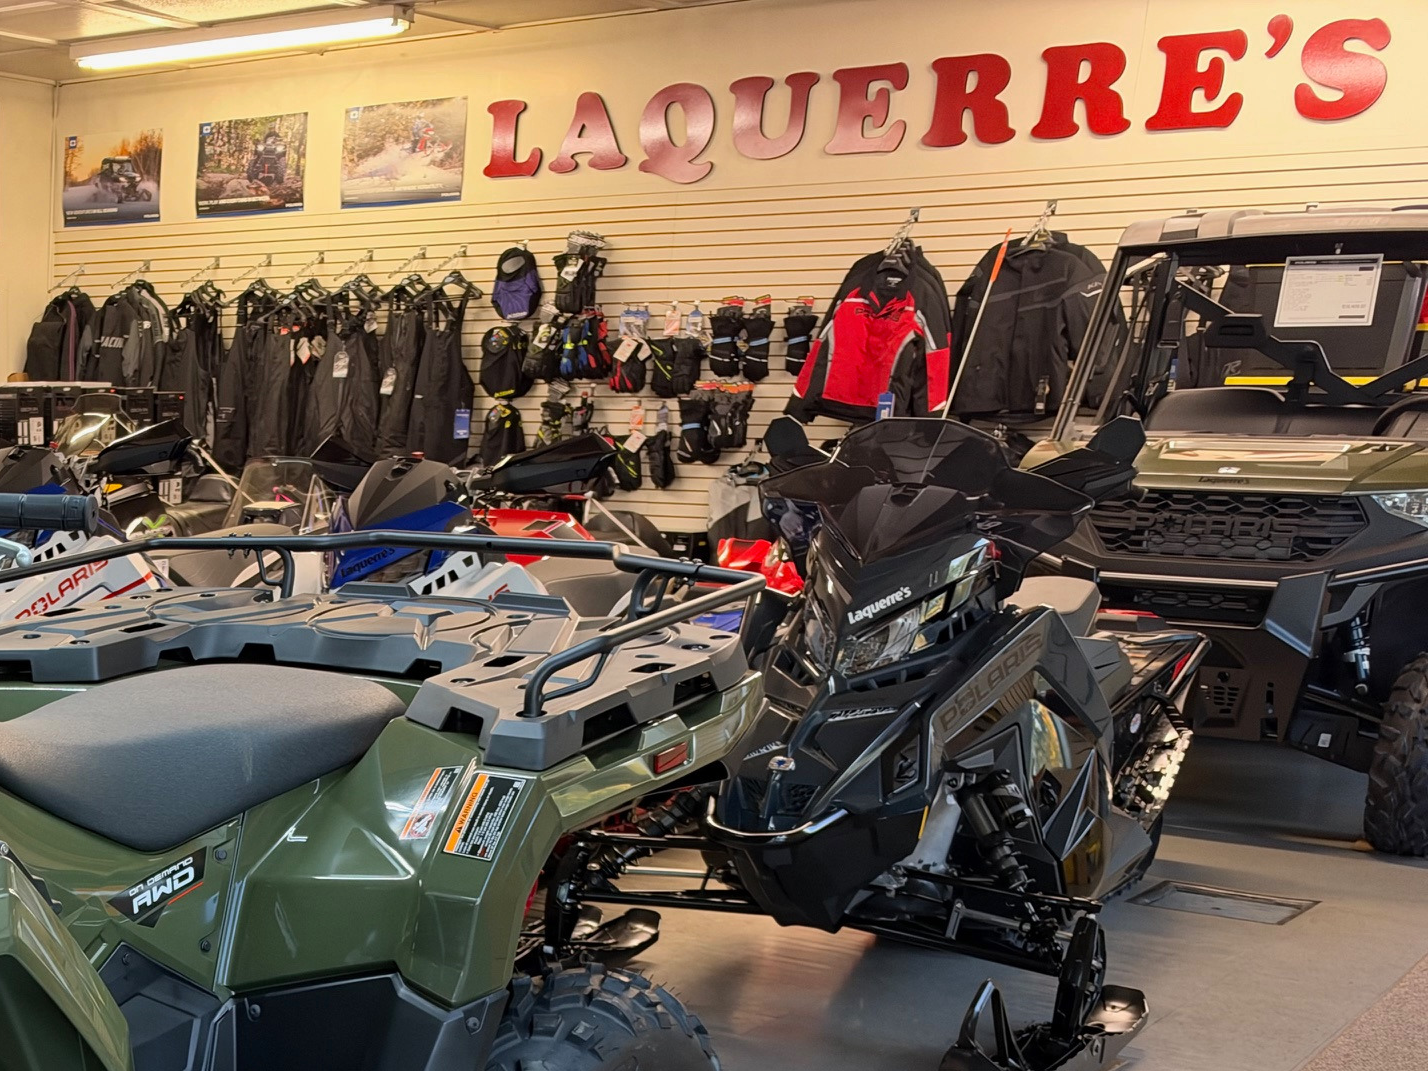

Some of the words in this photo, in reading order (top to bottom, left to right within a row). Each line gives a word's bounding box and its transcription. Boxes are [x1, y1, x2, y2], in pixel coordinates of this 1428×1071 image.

[483, 13, 1391, 184] LAQUERRE'S
[1128, 510, 1299, 538] POLARIS
[340, 547, 397, 579] Laquerre's
[847, 586, 912, 625] Laquerre's
[939, 632, 1044, 732] POLARIS
[458, 792, 478, 830] WARNING
[132, 866, 195, 915] AWD
[146, 856, 194, 887] DEMAND
